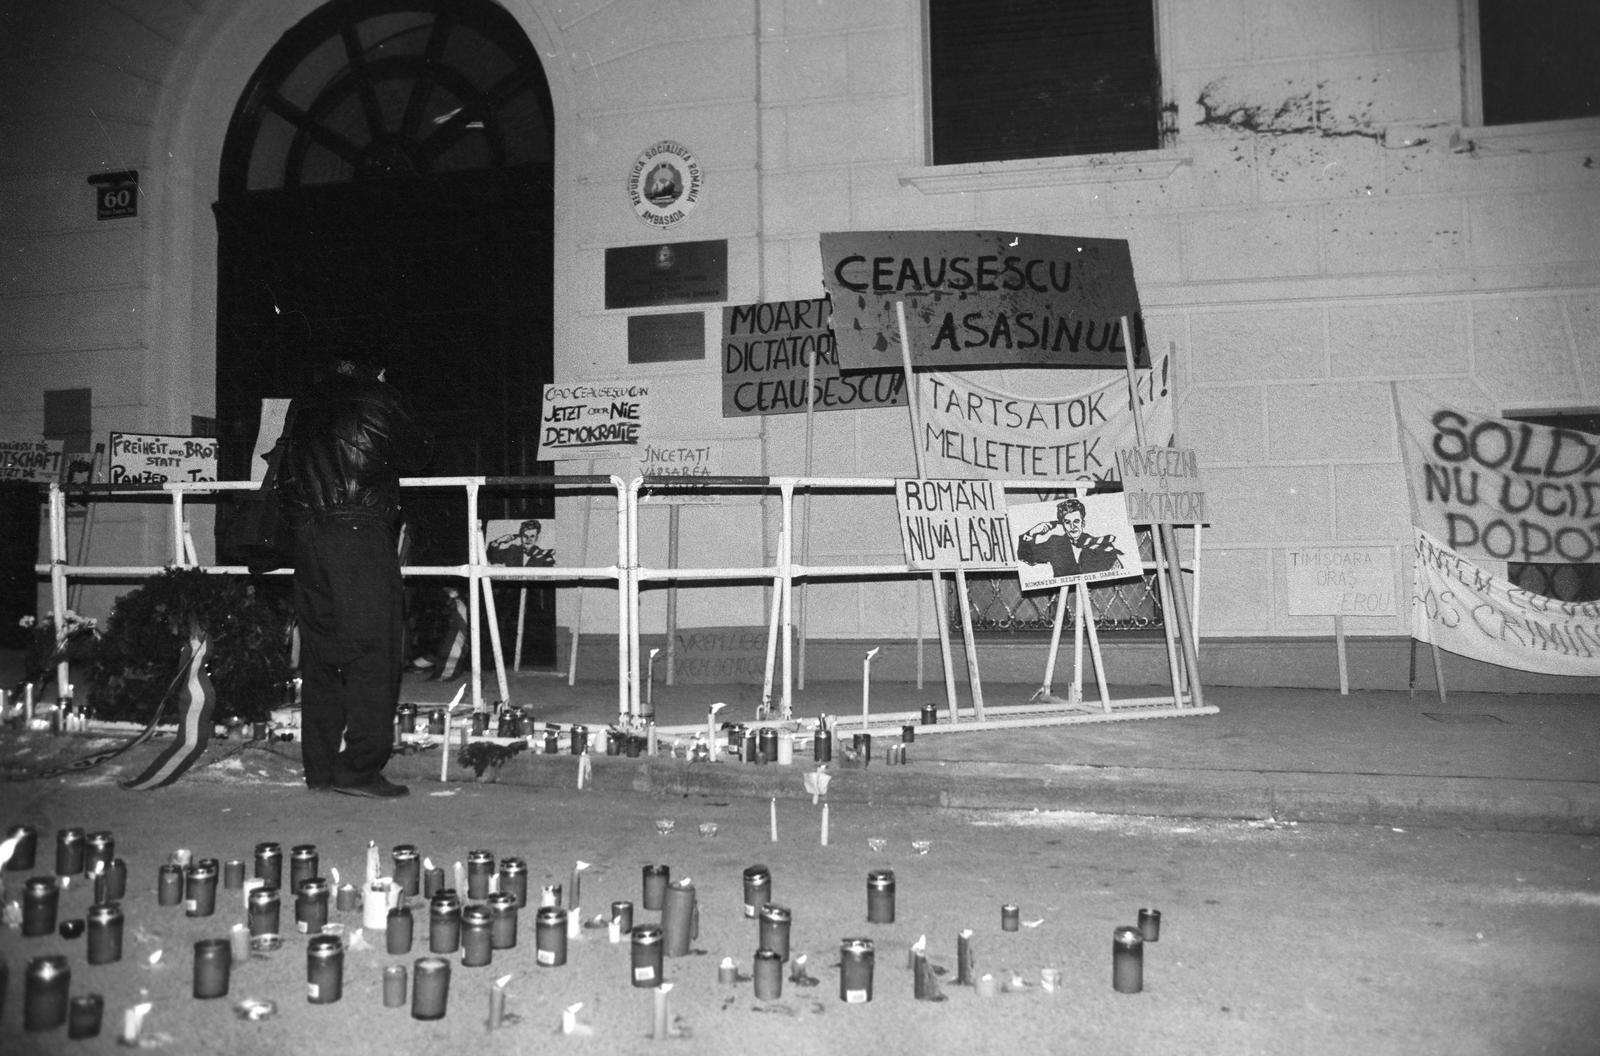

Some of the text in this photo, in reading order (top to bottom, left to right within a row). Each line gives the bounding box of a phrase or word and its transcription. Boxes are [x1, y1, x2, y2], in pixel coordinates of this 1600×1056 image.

[630, 160, 647, 206] REPUBLICA
[644, 144, 692, 162] SOCIALISTA
[104, 190, 130, 208] 60
[641, 209, 686, 226] AMBASADA
[834, 255, 1072, 293] CEAUSESCU
[930, 311, 1146, 364] ASASINUL!
[733, 373, 907, 413] CEAUSESCU!
[929, 377, 1108, 430] TARTSATOK
[543, 404, 588, 423] JETZT
[542, 421, 642, 446] DEMOKRATIE
[925, 422, 1103, 476] MELLETTETEK
[0, 450, 62, 472] TSCHAFT
[145, 456, 182, 468] STATT
[1424, 463, 1479, 507] NU
[905, 515, 936, 562] NU
